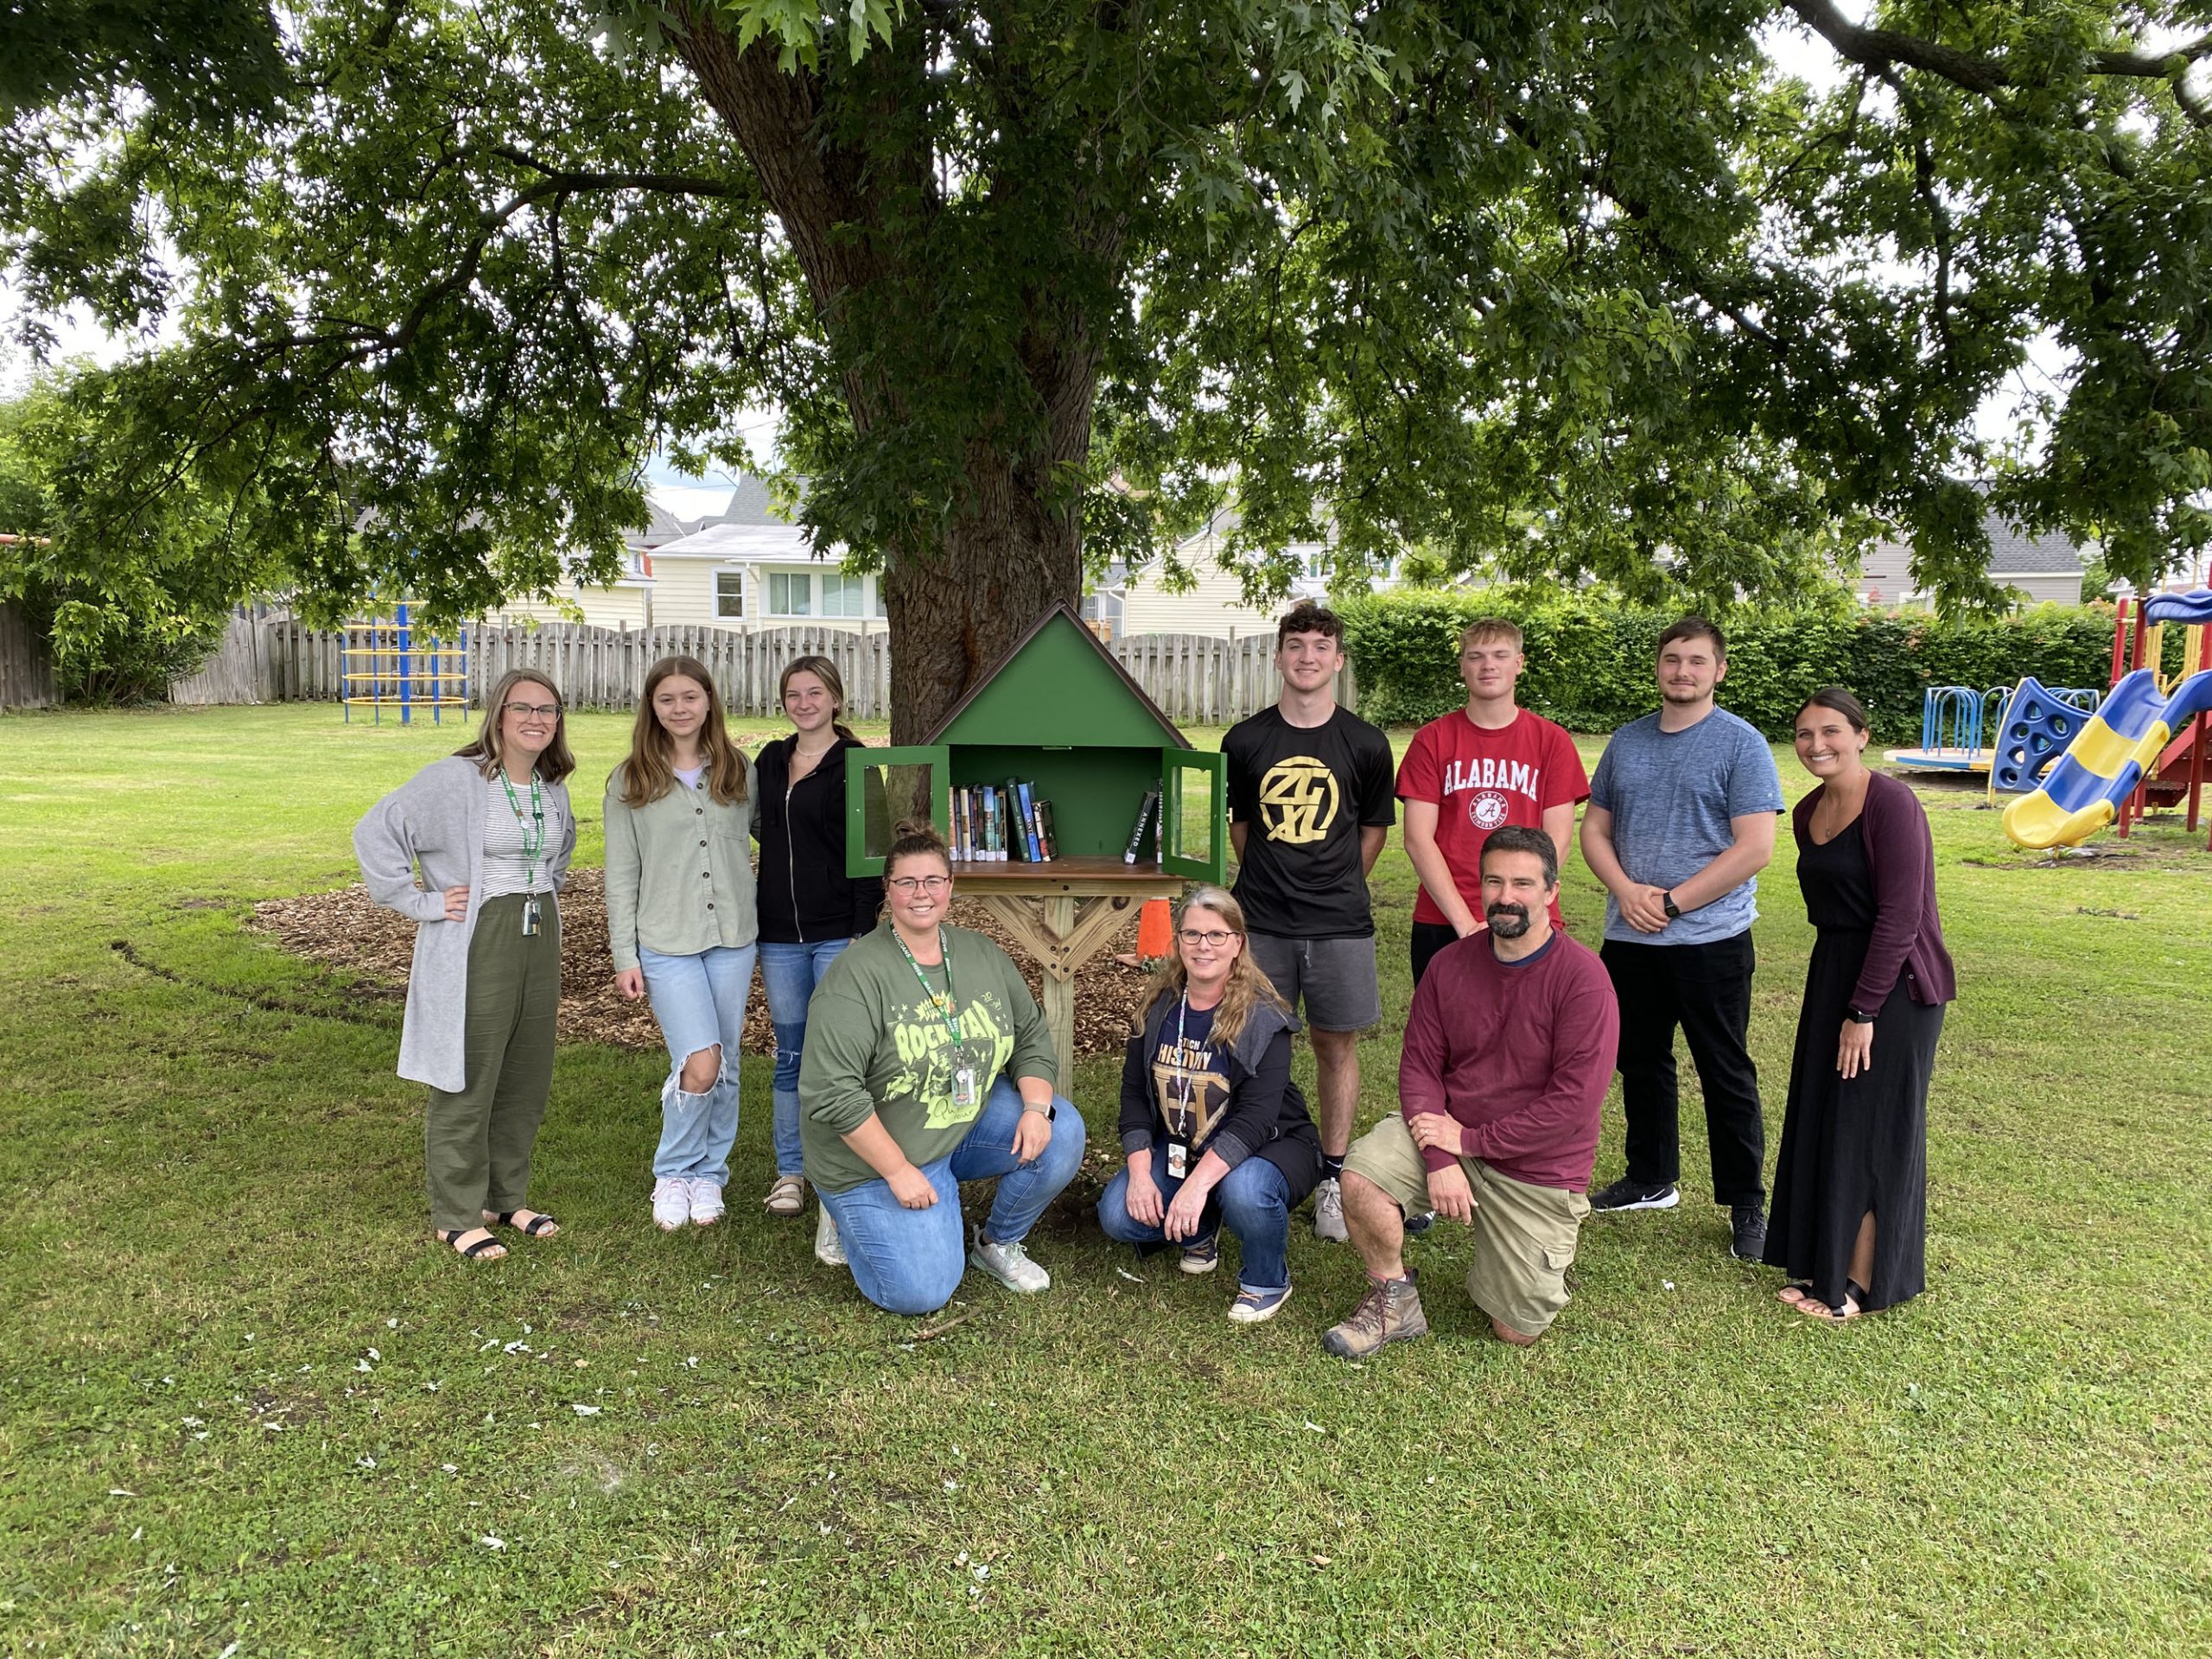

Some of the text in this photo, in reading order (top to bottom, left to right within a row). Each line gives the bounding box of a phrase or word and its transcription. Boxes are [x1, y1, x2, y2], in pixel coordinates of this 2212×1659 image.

[1444, 758, 1539, 802] ALABAMA
[1471, 792, 1506, 808] ALABAMA
[1478, 803, 1497, 817] A
[1133, 811, 1147, 847] ANNEXED
[894, 1000, 1001, 1067] ROCKTAR
